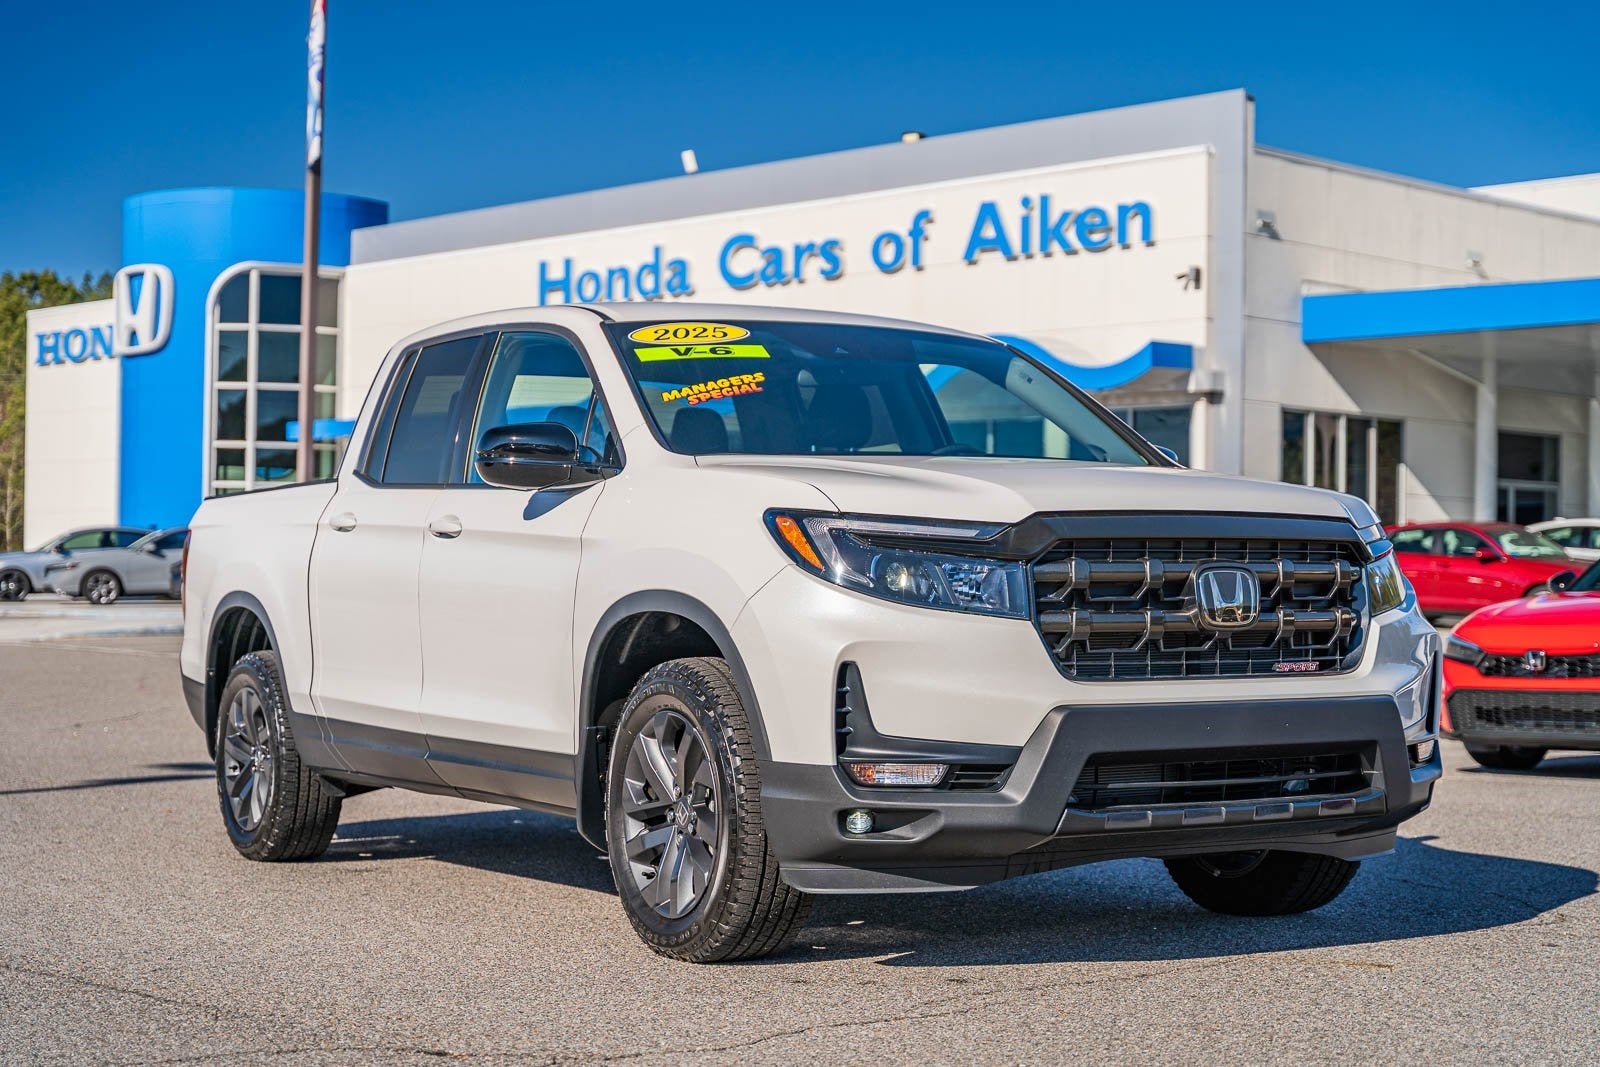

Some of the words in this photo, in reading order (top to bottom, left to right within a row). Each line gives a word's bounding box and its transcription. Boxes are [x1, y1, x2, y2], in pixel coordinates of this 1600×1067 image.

[538, 245, 693, 306] Honda
[719, 233, 845, 290] Cars
[871, 209, 932, 274] of
[962, 194, 1154, 264] Aiken
[654, 327, 728, 340] 2025
[670, 346, 732, 356] V-6
[661, 372, 765, 401] MANAGERS
[687, 382, 764, 406] SPECIAL
[1279, 662, 1319, 671] SPORT
